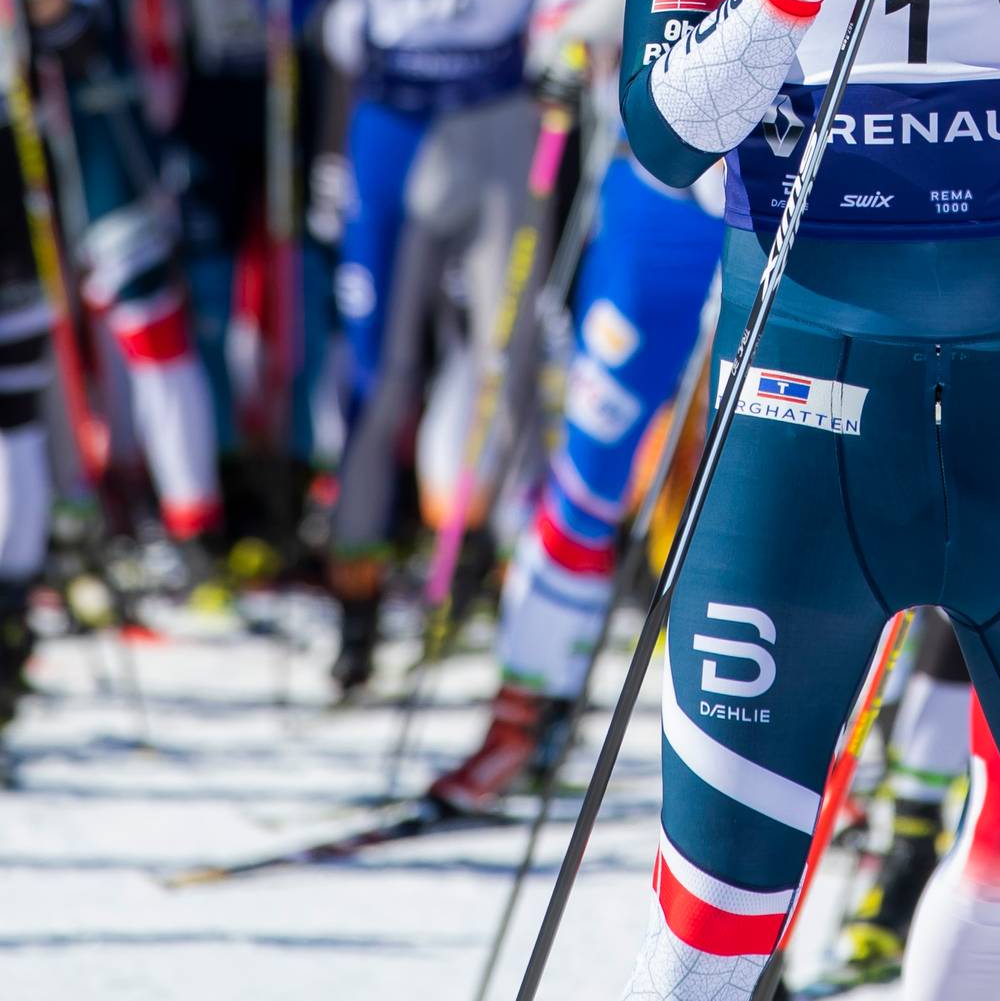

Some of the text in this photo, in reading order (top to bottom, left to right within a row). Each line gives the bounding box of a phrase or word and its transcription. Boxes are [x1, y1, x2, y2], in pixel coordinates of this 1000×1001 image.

[930, 189, 973, 201] REMA
[936, 203, 968, 213] 1000
[719, 395, 858, 433] RGHATTEN
[700, 700, 771, 723] DÆHLIE
